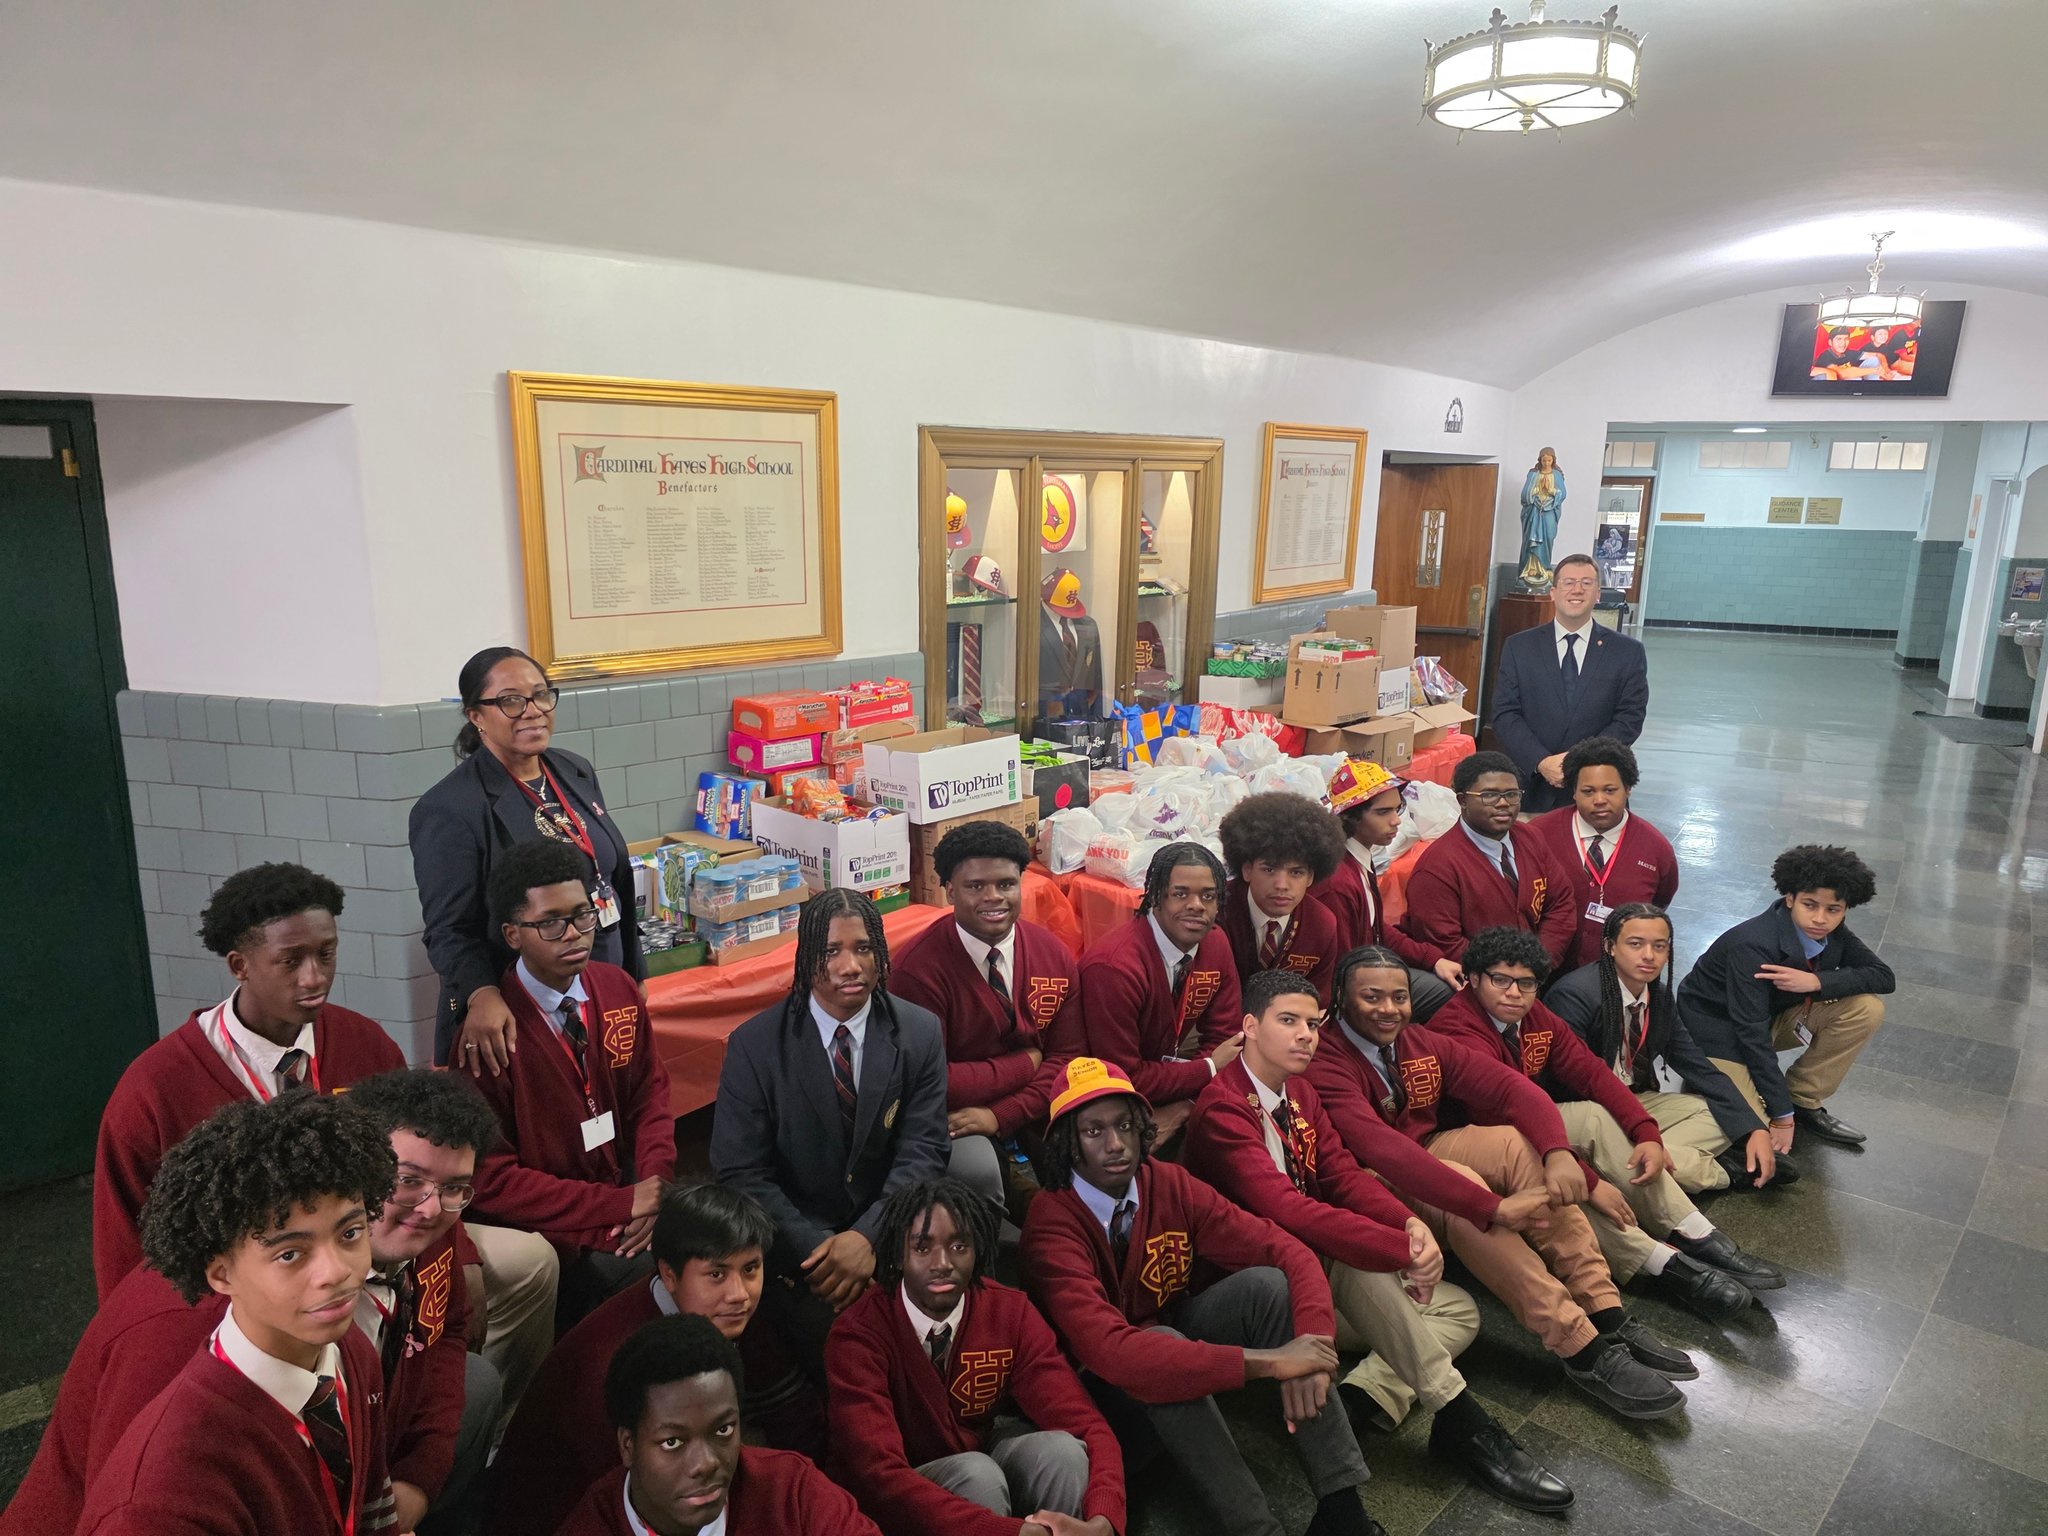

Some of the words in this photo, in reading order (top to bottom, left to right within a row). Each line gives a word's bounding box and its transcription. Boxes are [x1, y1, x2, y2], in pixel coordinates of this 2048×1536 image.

[657, 480, 718, 496] Benefactors
[949, 772, 1004, 797] TopPrint
[704, 787, 713, 820] VIENNA
[1106, 847, 1129, 860] YOU
[1072, 1061, 1096, 1071] HAYES
